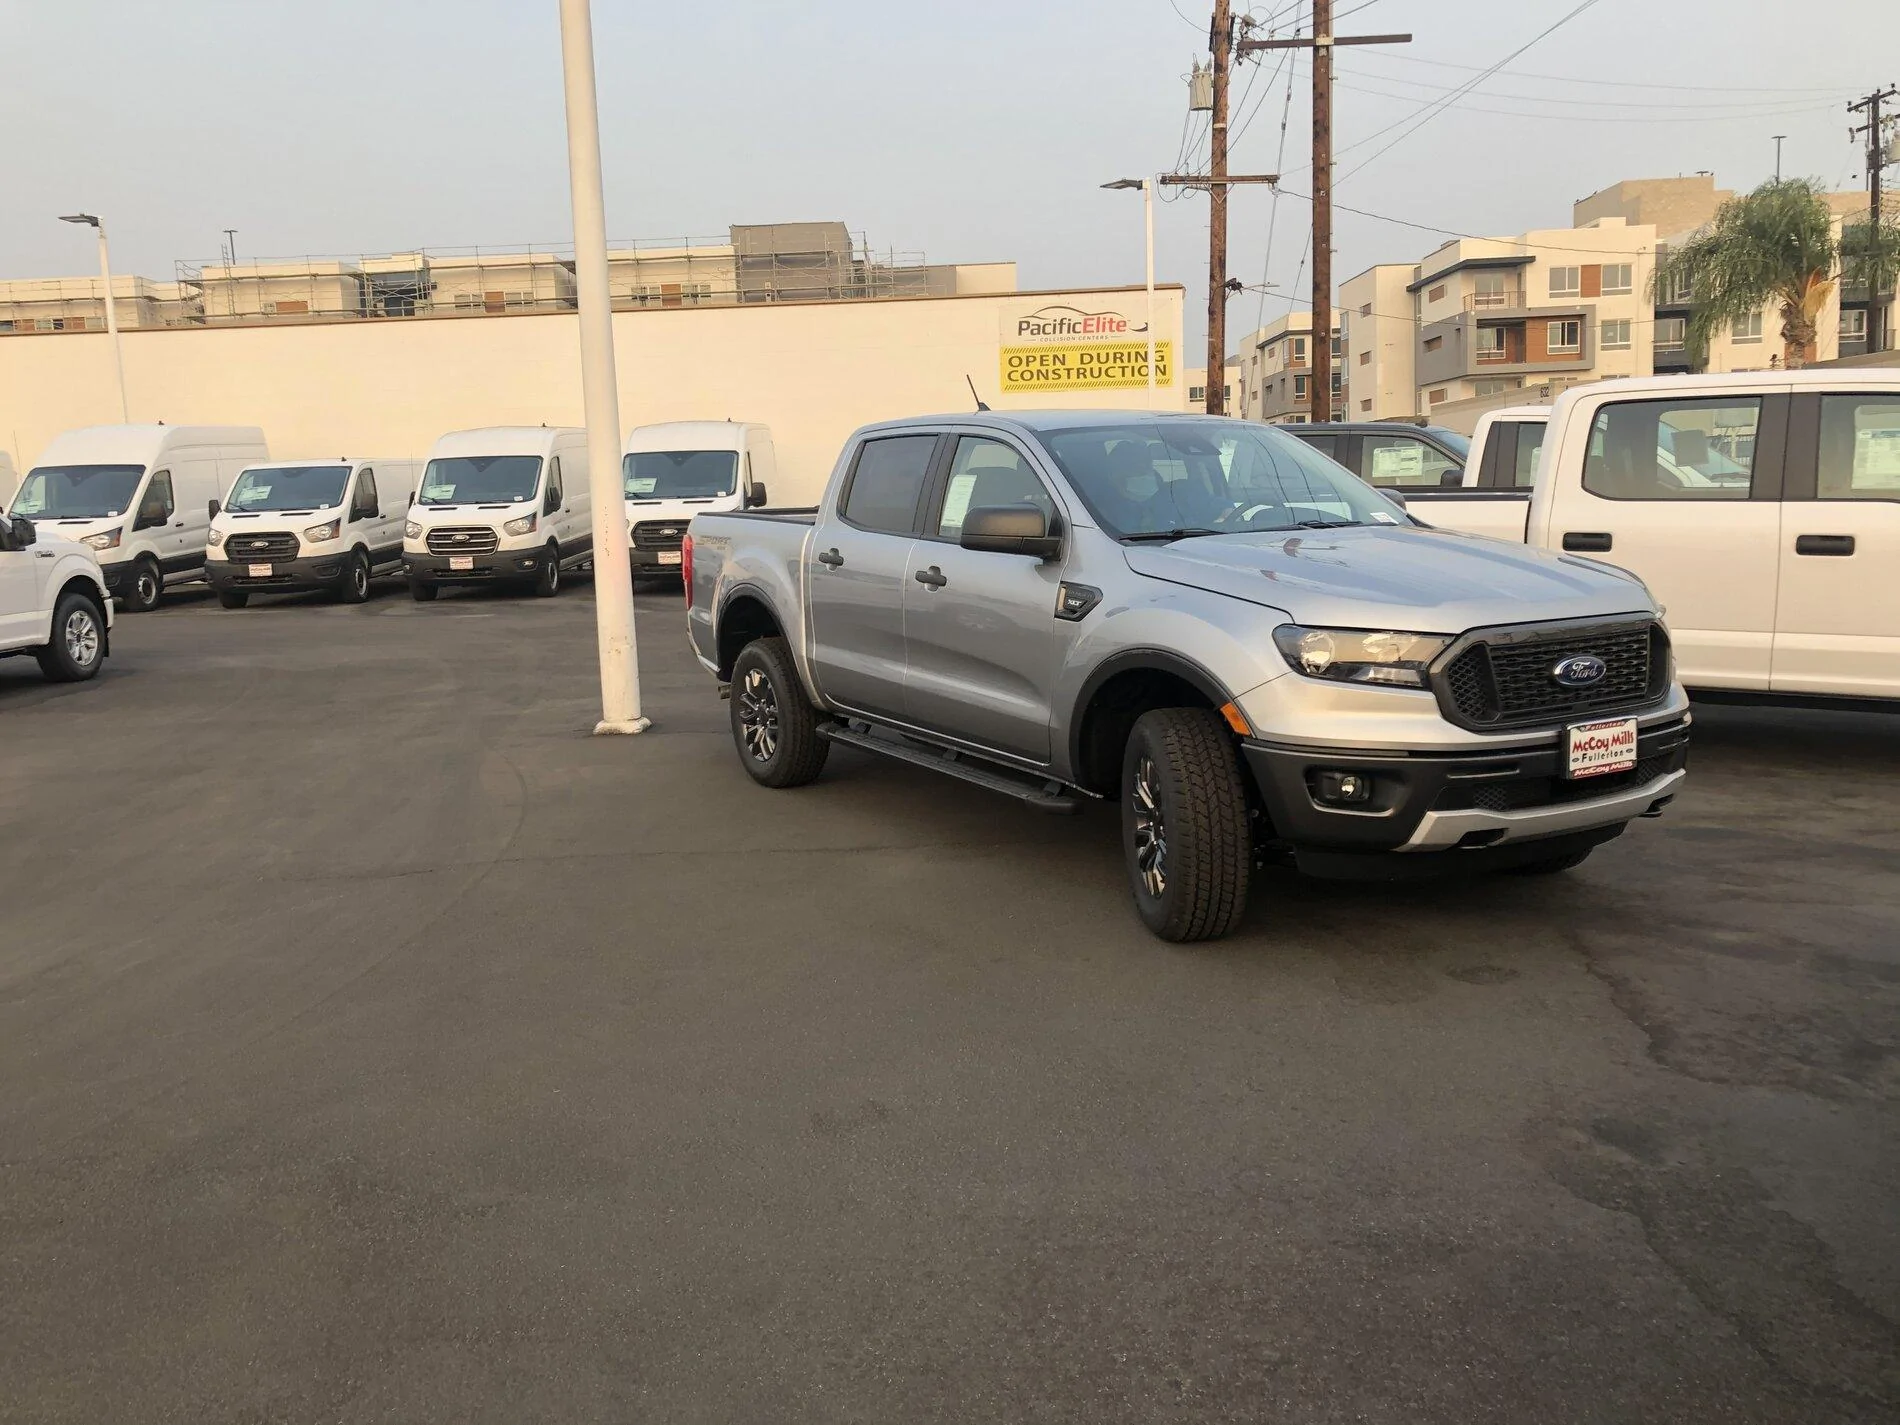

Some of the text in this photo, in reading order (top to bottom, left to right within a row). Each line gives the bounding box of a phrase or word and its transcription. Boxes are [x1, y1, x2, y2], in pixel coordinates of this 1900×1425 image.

[1017, 316, 1127, 337] PacificElite
[1007, 350, 1165, 368] OPEN DURING
[1007, 364, 1167, 382] CONSTRUCTION
[1570, 661, 1598, 679] Ford
[1572, 730, 1634, 753] McCoy Mills
[1581, 750, 1624, 763] Fullerton
[1574, 760, 1633, 776] McCoy Mills
